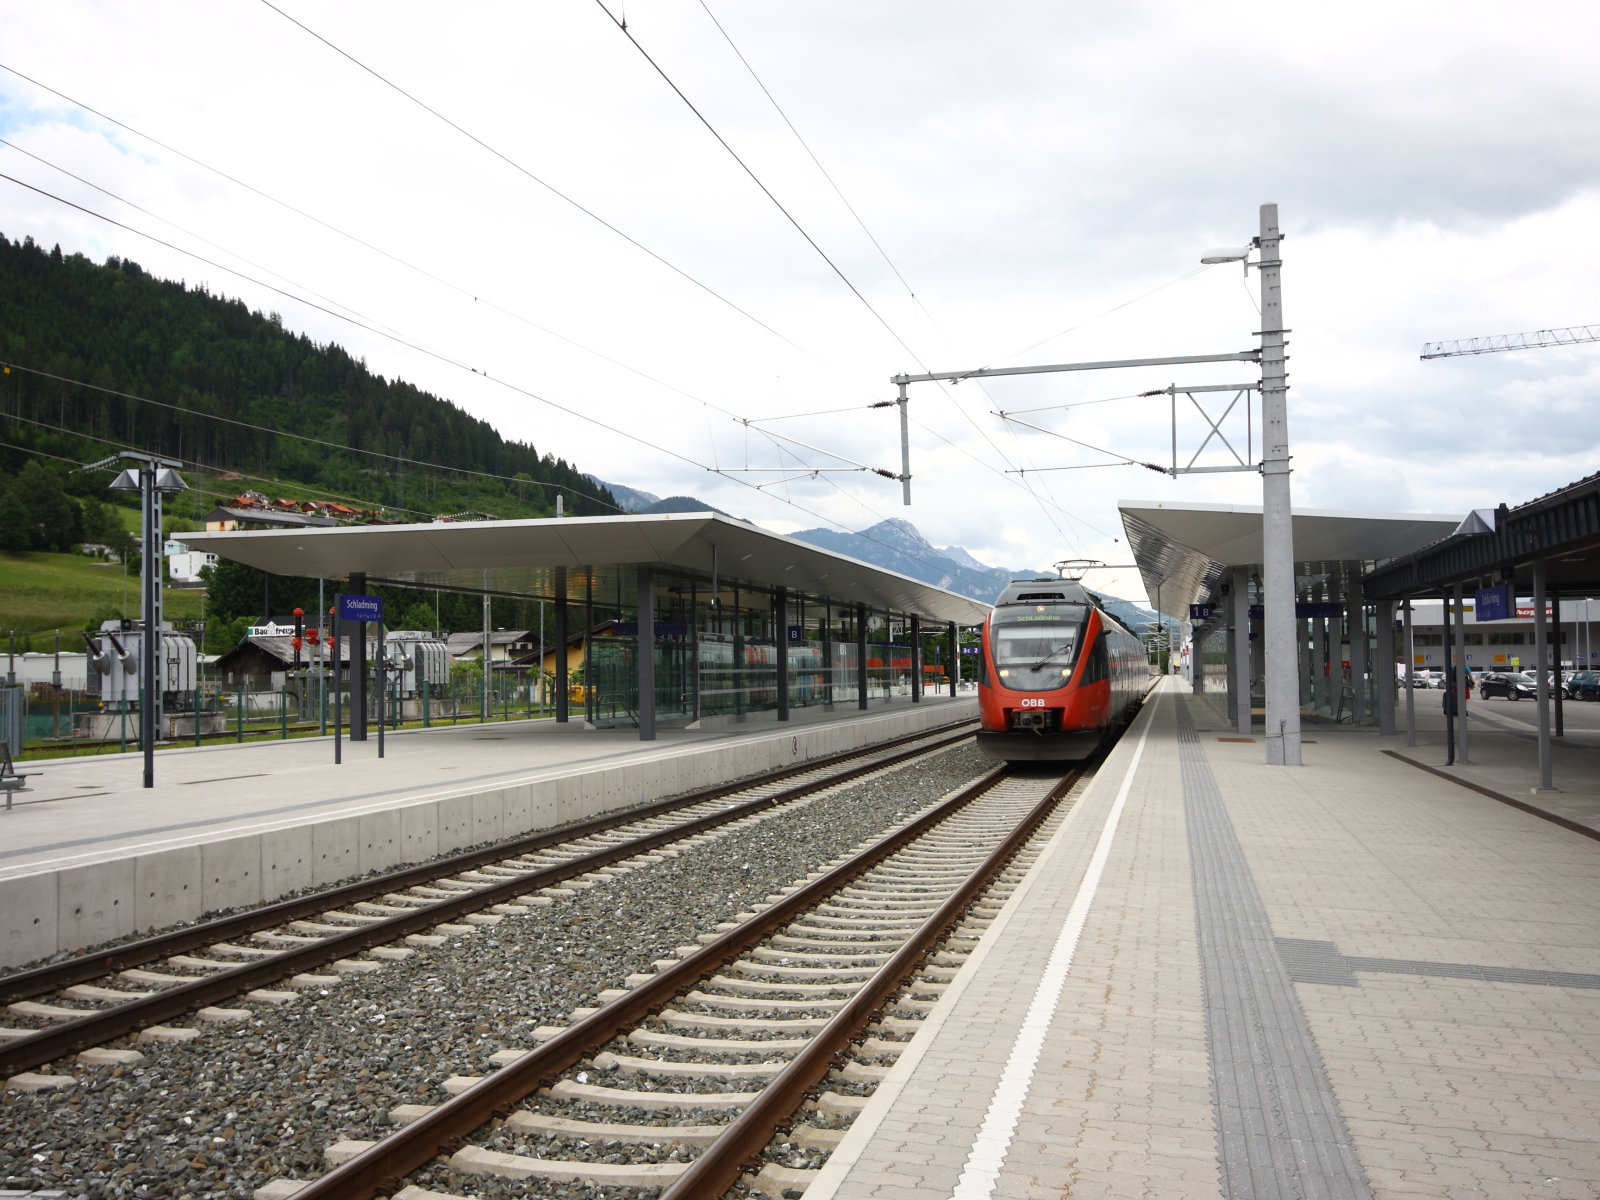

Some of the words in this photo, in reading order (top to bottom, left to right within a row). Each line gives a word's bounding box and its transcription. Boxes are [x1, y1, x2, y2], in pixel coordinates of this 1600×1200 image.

[346, 599, 378, 612] Schladming
[1194, 606, 1199, 617] 1
[1203, 608, 1209, 617] B
[791, 630, 798, 639] B
